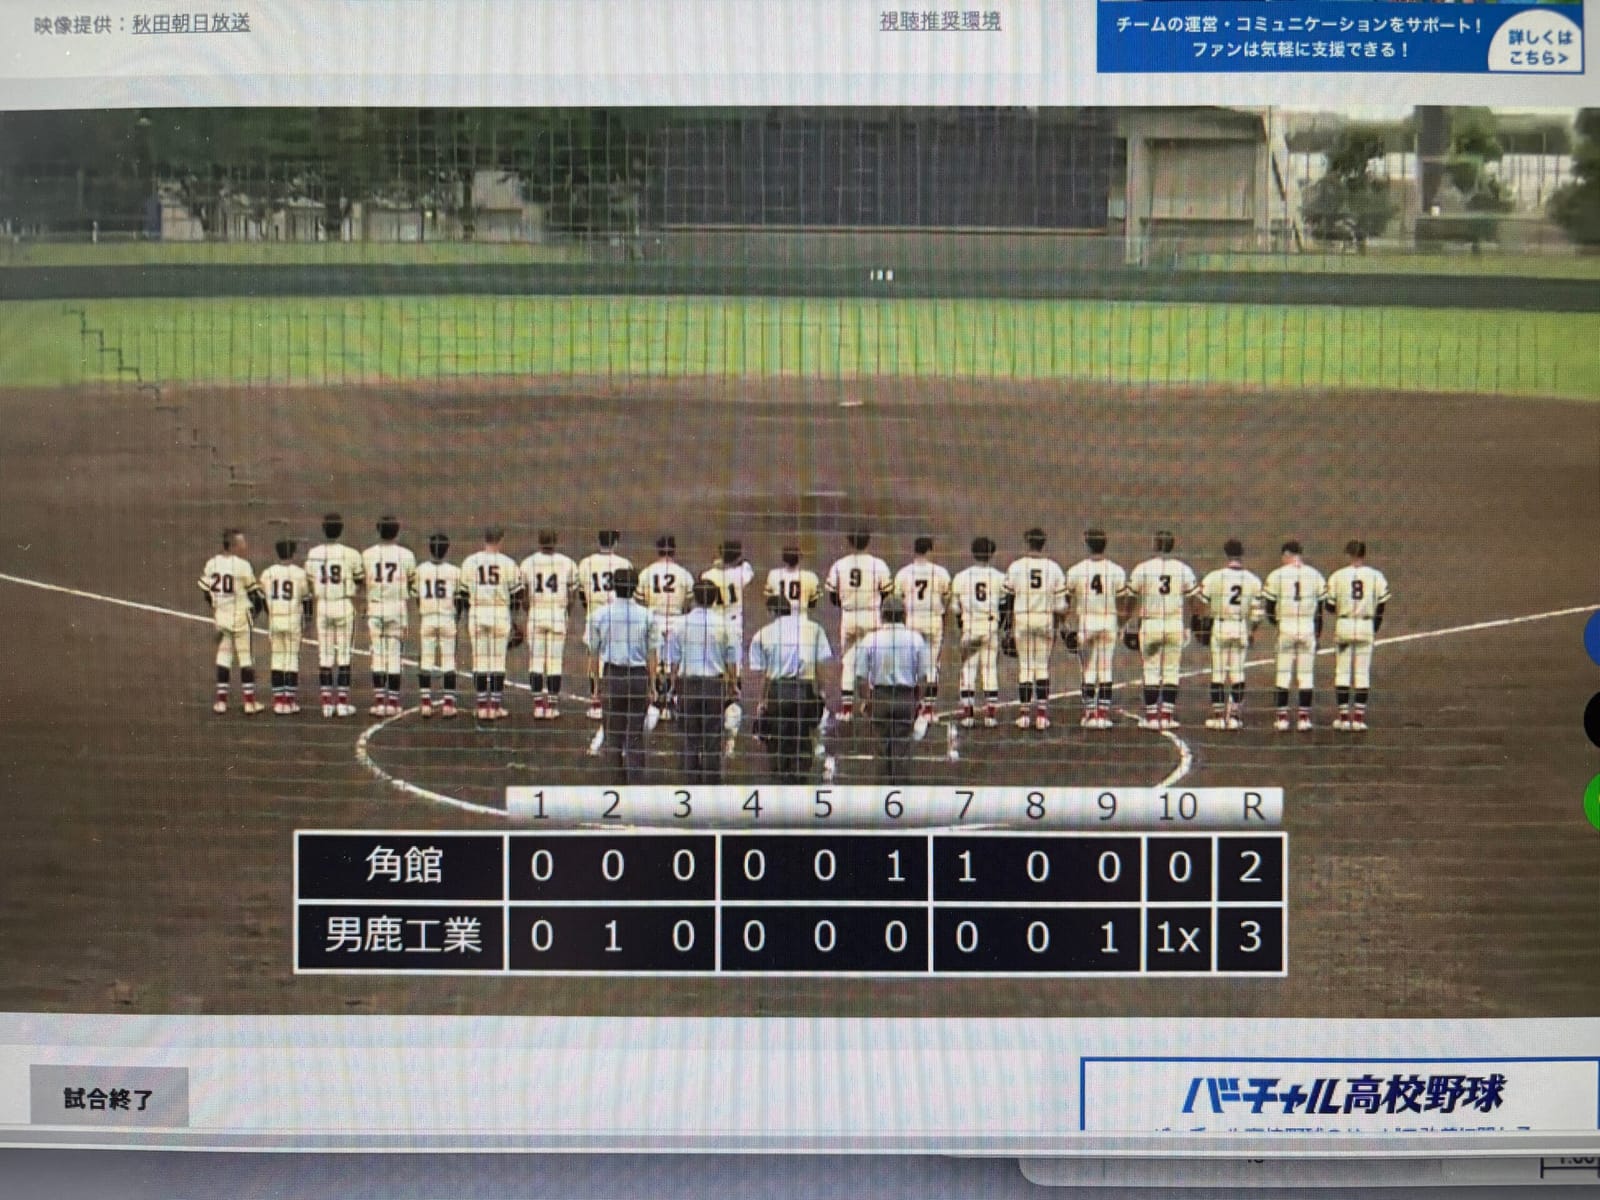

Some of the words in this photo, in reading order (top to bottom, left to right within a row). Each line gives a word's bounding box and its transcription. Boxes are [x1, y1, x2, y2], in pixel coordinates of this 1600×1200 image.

[880, 10, 1001, 31] 視聴推奨環境
[1508, 29, 1573, 46] 詳しくは
[1193, 40, 1408, 57] ファンは気軽に支援できる！
[319, 564, 342, 584] 18
[374, 562, 397, 583] 17
[478, 565, 500, 585] 15
[591, 572, 614, 592] 13
[849, 568, 862, 588] 9
[1029, 569, 1042, 589] 5
[210, 573, 234, 594] 20
[270, 580, 294, 600] 19
[424, 579, 447, 599] 16
[534, 573, 558, 593] 14
[652, 574, 675, 594] 12
[779, 580, 800, 600] 10
[915, 579, 928, 600] 7
[975, 582, 987, 602] 6
[1090, 574, 1103, 594] 4
[1159, 575, 1171, 595] 3
[1292, 581, 1301, 600] 1
[1229, 585, 1242, 605] 2
[533, 791, 549, 820] 1
[602, 791, 621, 820] 2
[673, 791, 692, 820] 3
[742, 791, 763, 819] 4
[814, 790, 833, 819] 5
[884, 790, 904, 819] 6
[955, 791, 975, 820] 7
[1026, 792, 1046, 820] 8
[1098, 792, 1118, 821] 9
[1159, 793, 1198, 821] 10
[1244, 793, 1264, 821] R
[365, 845, 443, 883] 角館
[532, 850, 553, 882] 0
[602, 850, 624, 882] 0
[673, 850, 694, 882] 0
[744, 850, 765, 882] 0
[815, 850, 836, 882] 0
[888, 850, 905, 882] 1
[959, 850, 976, 882] 1
[1027, 850, 1049, 882] 0
[1099, 850, 1120, 882] 0
[1170, 850, 1191, 882] 0
[1240, 850, 1261, 882] 2
[325, 915, 482, 953] 男鹿工業
[532, 920, 553, 952] 0
[605, 920, 622, 952] 1
[673, 920, 694, 952] 0
[744, 920, 765, 952] 0
[815, 920, 836, 952] 0
[885, 920, 907, 952] 0
[957, 920, 978, 952] 0
[1027, 920, 1049, 952] 0
[1102, 920, 1118, 952] 1
[1157, 920, 1200, 952] 1x
[1240, 920, 1261, 952] 3
[64, 1088, 152, 1111] 試合終了
[1181, 1074, 1507, 1114] バーチャル高校野球
